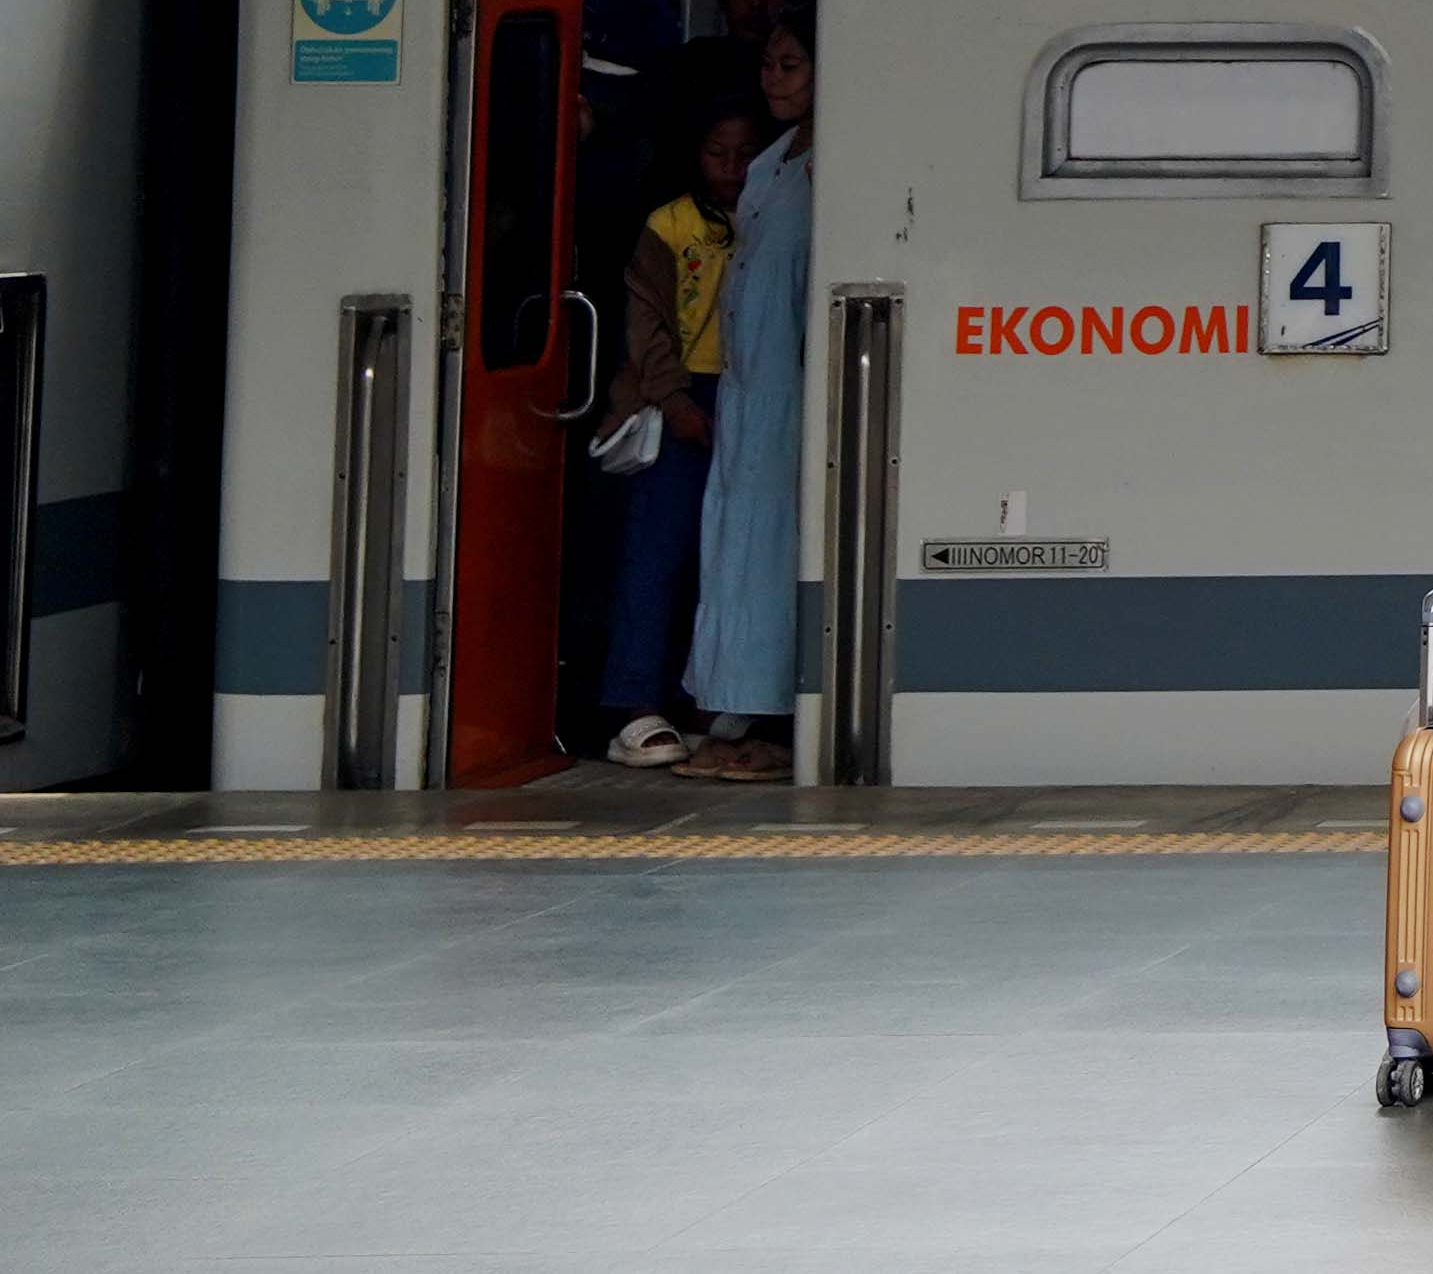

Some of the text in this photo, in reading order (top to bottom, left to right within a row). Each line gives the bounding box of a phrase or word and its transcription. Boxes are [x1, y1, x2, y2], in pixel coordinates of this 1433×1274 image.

[1289, 241, 1353, 316] 4
[955, 305, 1249, 356] EKONOMI
[970, 546, 1098, 565] NOMOR 11-20
